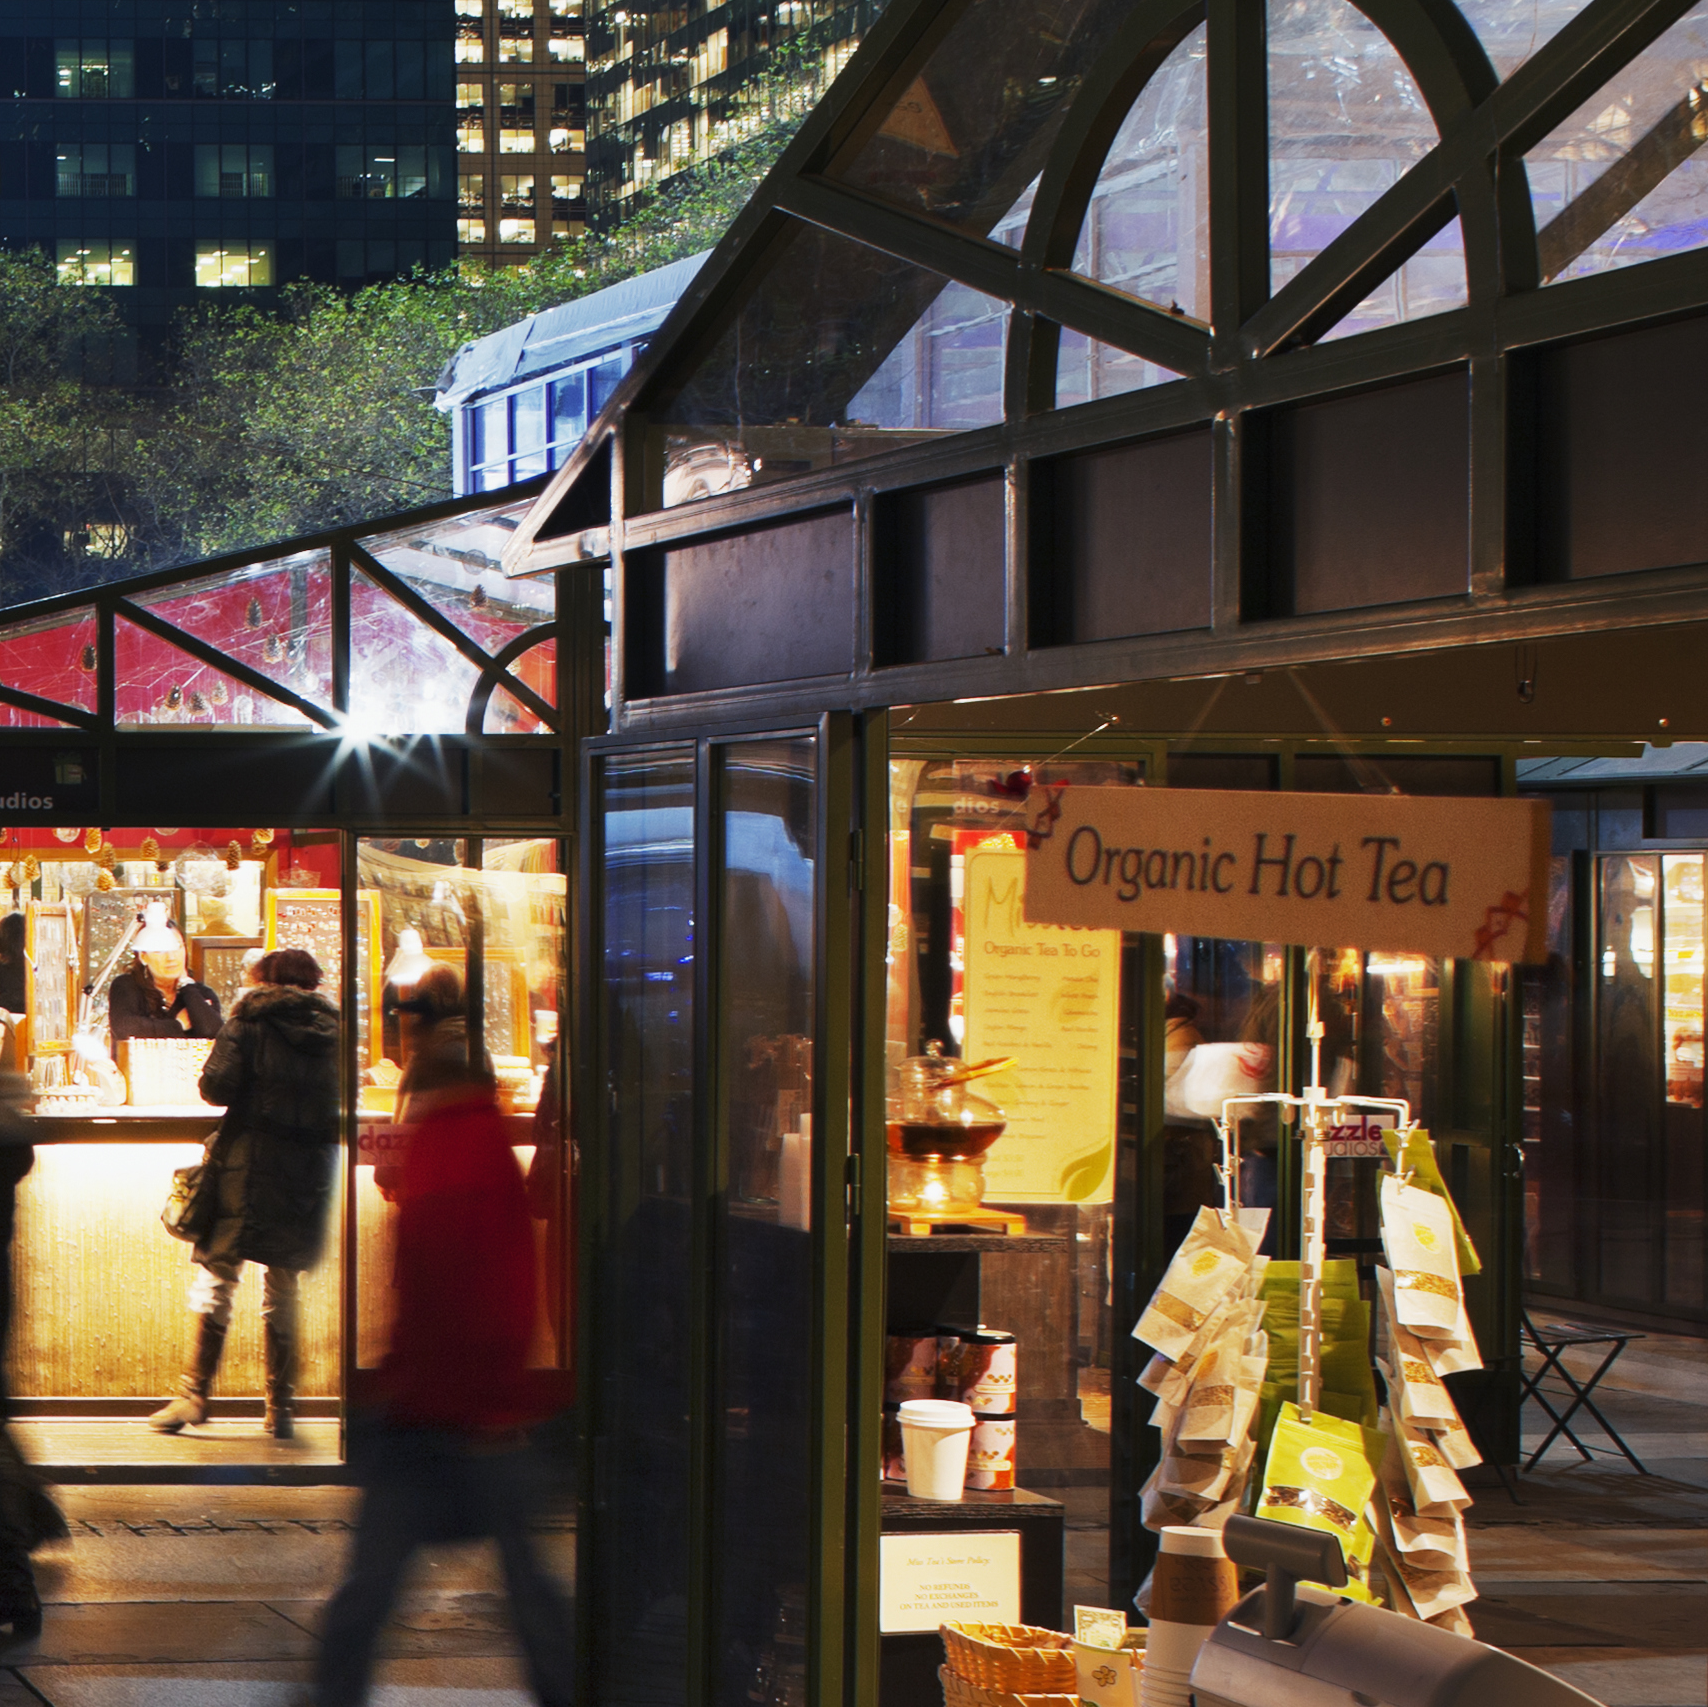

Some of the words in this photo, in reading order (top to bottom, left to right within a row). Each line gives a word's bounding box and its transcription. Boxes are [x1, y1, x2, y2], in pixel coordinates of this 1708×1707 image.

[1065, 825, 1236, 903] Organic
[1248, 832, 1344, 900] Hot
[1361, 836, 1450, 906] Tea
[984, 940, 1033, 958] Organic
[1036, 942, 1059, 957] Tea
[1062, 943, 1078, 957] To
[1081, 943, 1101, 957] Go
[1327, 1115, 1383, 1141] zzle
[933, 1583, 971, 1591] REFUNDS
[929, 1592, 979, 1600] EXCHANGES
[932, 1602, 950, 1610] AND
[973, 1600, 999, 1608] ITEMS
